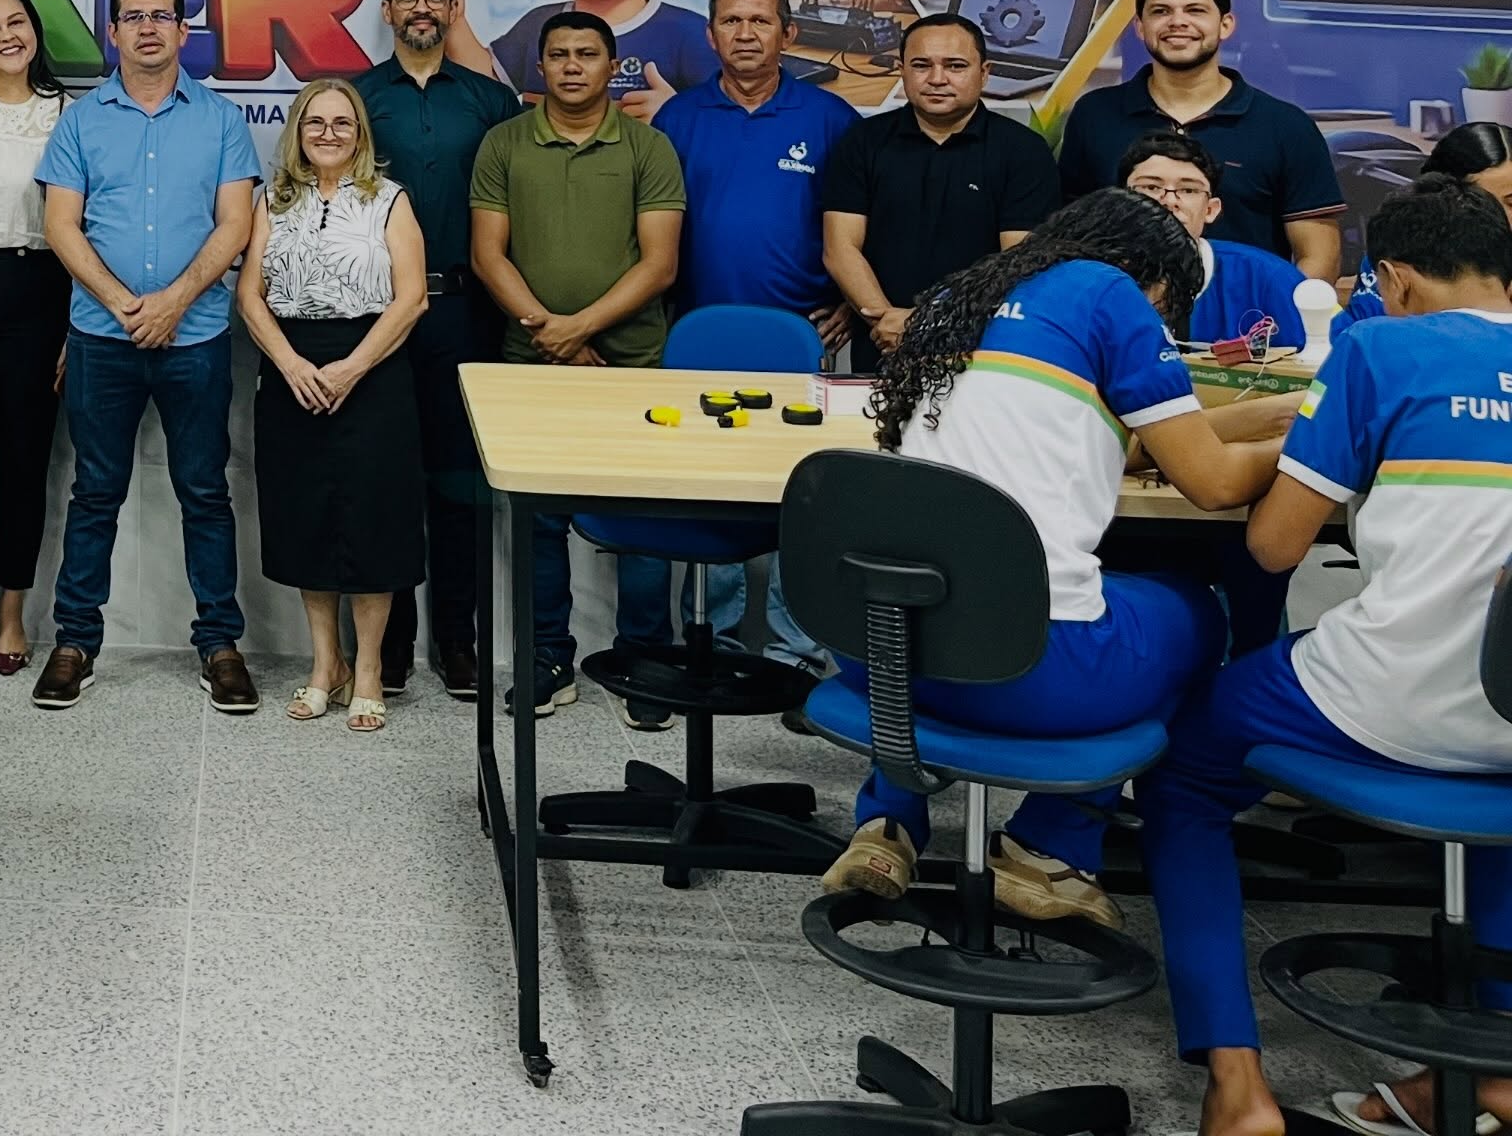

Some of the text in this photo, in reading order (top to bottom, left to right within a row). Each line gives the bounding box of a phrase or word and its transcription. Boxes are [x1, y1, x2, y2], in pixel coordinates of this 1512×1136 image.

[236, 104, 294, 124] MA
[992, 301, 1025, 321] AL
[1498, 371, 1512, 393] E
[1450, 395, 1512, 422] FUN
